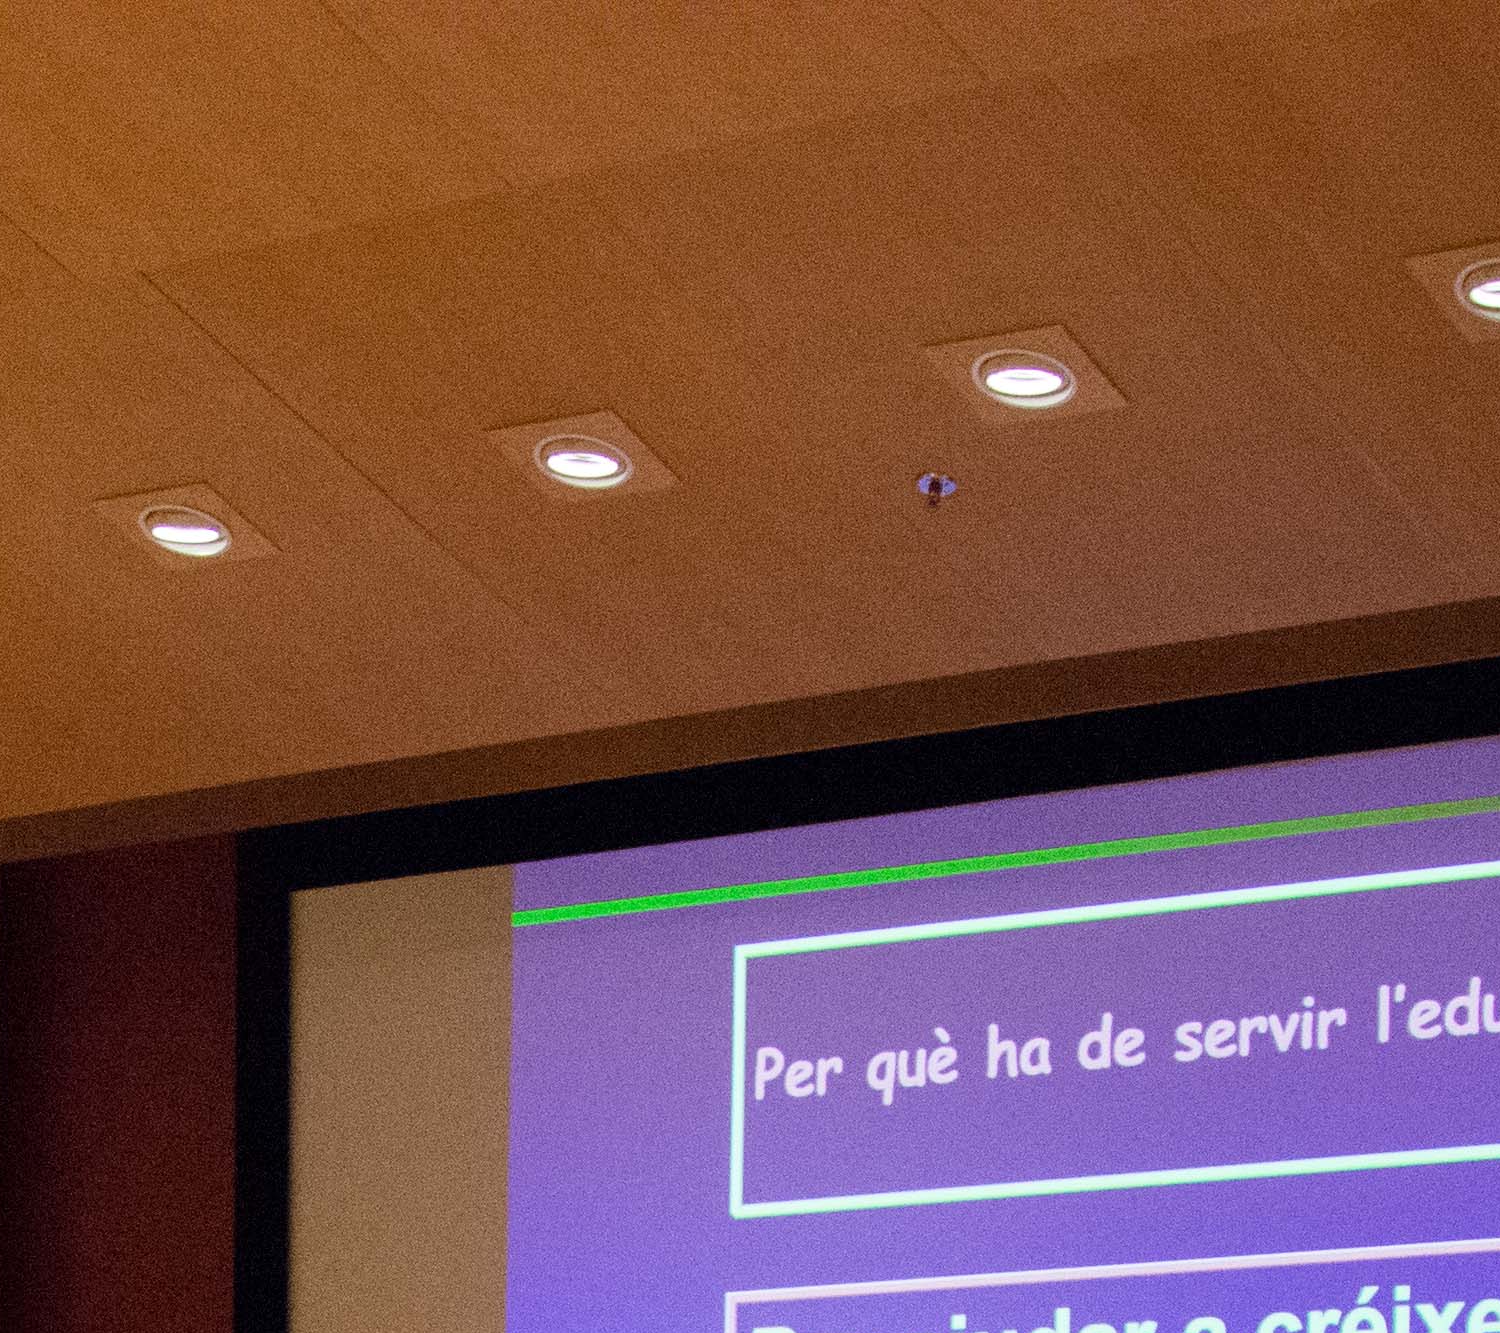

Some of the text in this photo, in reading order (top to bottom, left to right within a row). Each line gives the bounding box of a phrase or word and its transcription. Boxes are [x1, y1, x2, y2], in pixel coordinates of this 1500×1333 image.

[754, 1046, 844, 1102] Per
[866, 1026, 960, 1106] què
[986, 1023, 1053, 1080] ha
[1077, 1011, 1147, 1071] de
[1172, 995, 1347, 1064] servir
